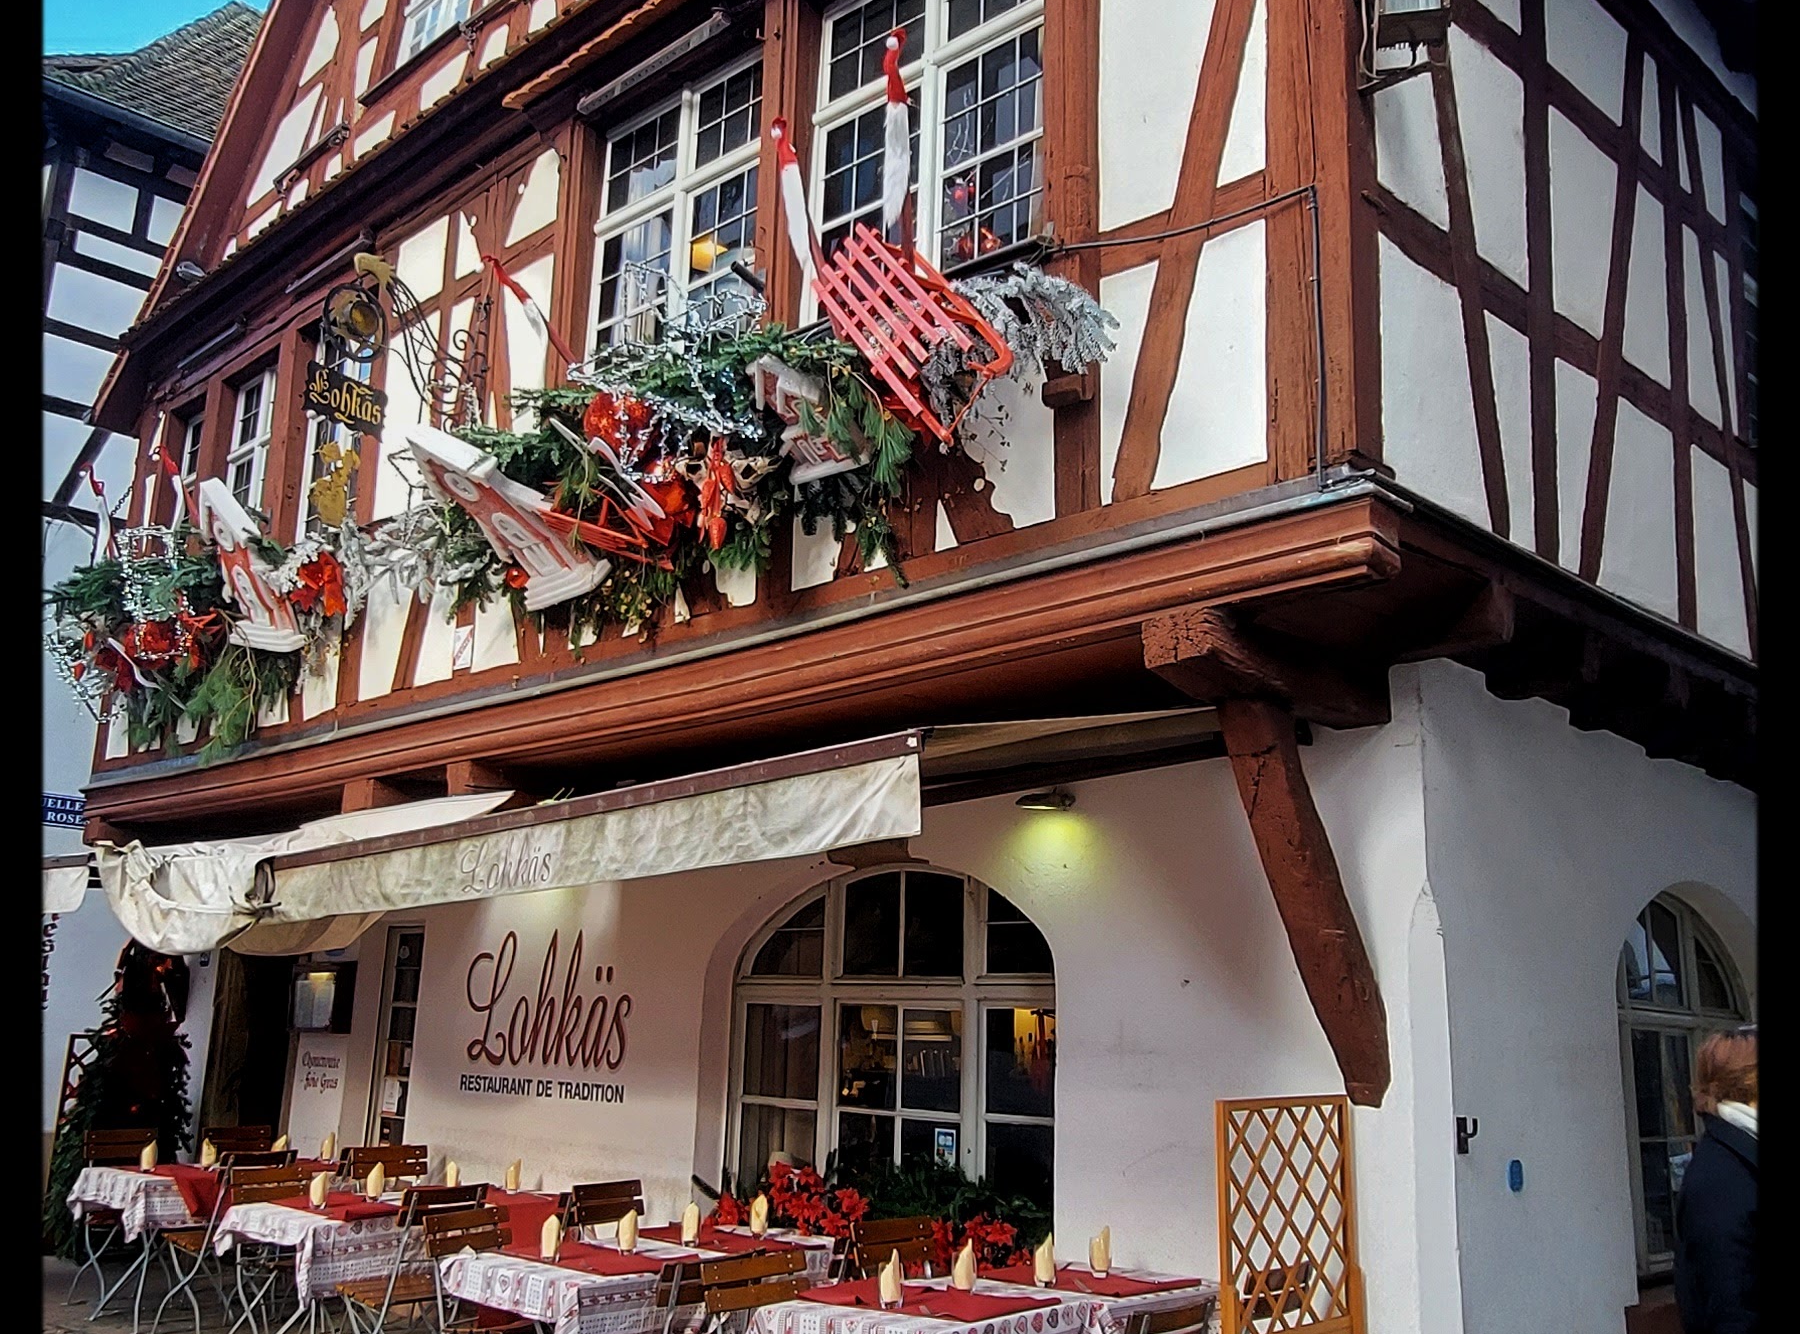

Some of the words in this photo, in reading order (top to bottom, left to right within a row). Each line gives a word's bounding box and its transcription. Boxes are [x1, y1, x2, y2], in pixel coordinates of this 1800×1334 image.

[309, 369, 381, 425] Lohkäs
[461, 833, 551, 893] Lohkäs
[466, 928, 632, 1070] Lohkäs
[459, 1074, 533, 1096] RESTAURANT
[536, 1079, 553, 1098] DE
[558, 1081, 625, 1104] TRADITION
